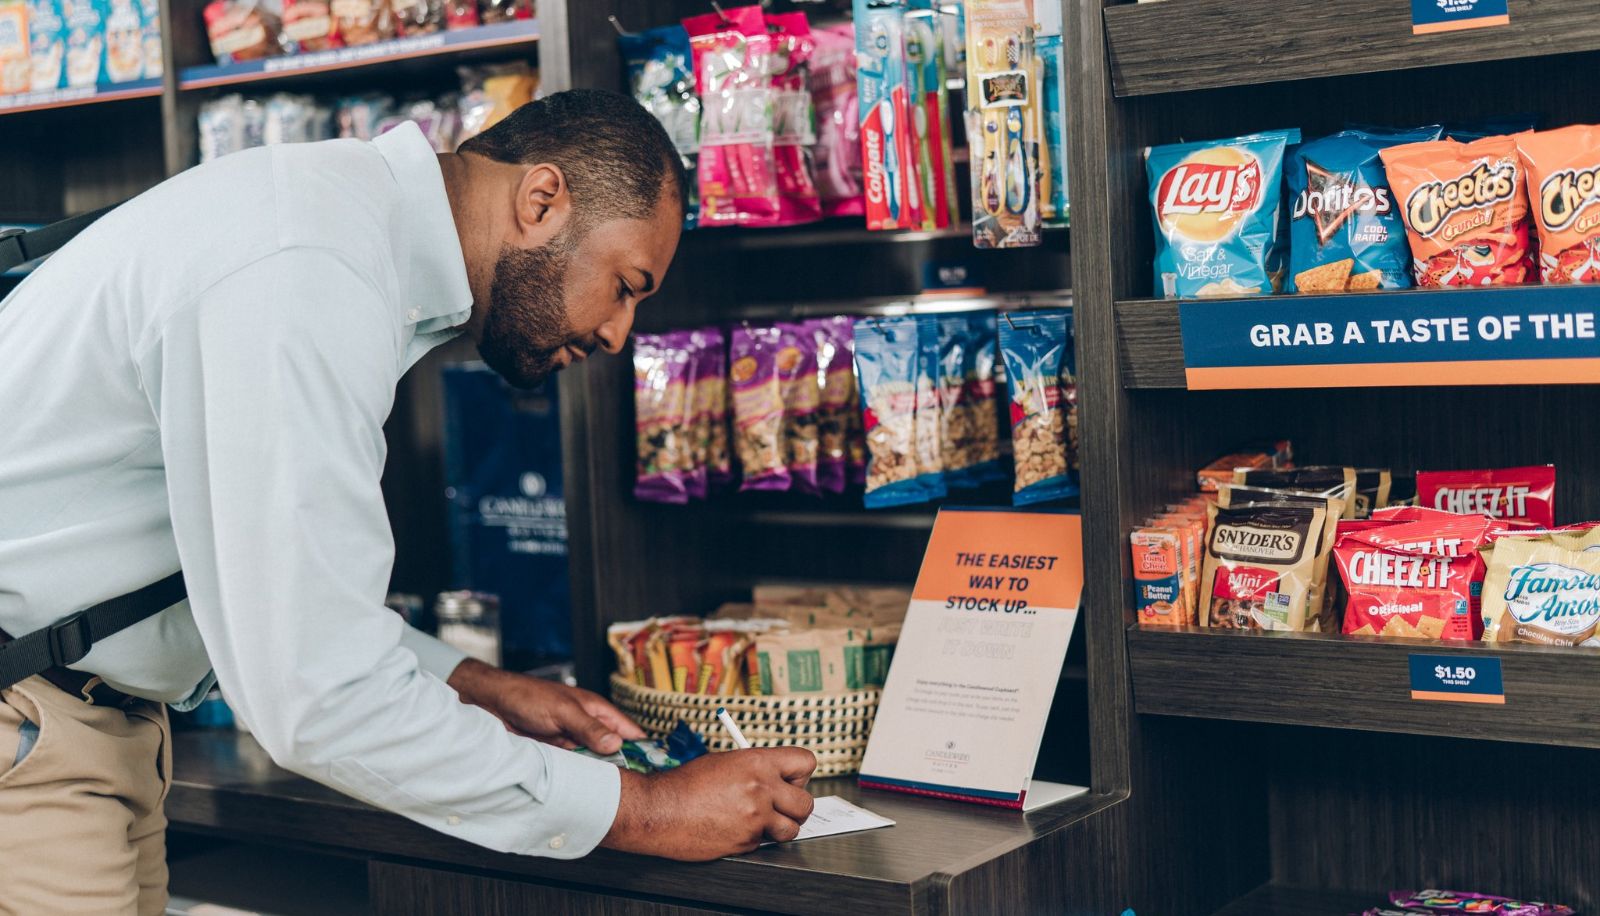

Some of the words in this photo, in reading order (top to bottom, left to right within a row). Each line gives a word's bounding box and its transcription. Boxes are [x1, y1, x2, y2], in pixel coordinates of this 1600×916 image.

[866, 130, 884, 203] Colgate
[1162, 163, 1256, 215] Lay's
[1293, 182, 1391, 219] Doritos
[1407, 163, 1516, 236] Cheetos
[1354, 233, 1388, 242] RANCH
[1363, 225, 1388, 234] COOL
[1182, 247, 1214, 262] Salt
[1216, 249, 1226, 260] &
[1176, 262, 1234, 279] Vinegar
[1249, 322, 1334, 348] GRAB
[1342, 321, 1366, 345] A
[1370, 317, 1470, 344] TASTE
[1477, 315, 1521, 341] OF
[1528, 312, 1596, 339] THE
[1217, 528, 1295, 551] SNYDER'S
[956, 552, 986, 567] THE
[988, 554, 1058, 571] EASIEST
[969, 575, 1005, 590] WAY
[1008, 577, 1029, 592] TO
[1147, 585, 1173, 593] Peanut
[1228, 572, 1262, 588] Mini
[1504, 566, 1600, 601] Famous
[945, 595, 1001, 612] STOCK
[1004, 599, 1037, 615] UP...
[1148, 592, 1171, 600] Butter
[1519, 594, 1600, 622] Amos
[1517, 628, 1554, 645] Chocolate
[1434, 664, 1476, 680] $1.50
